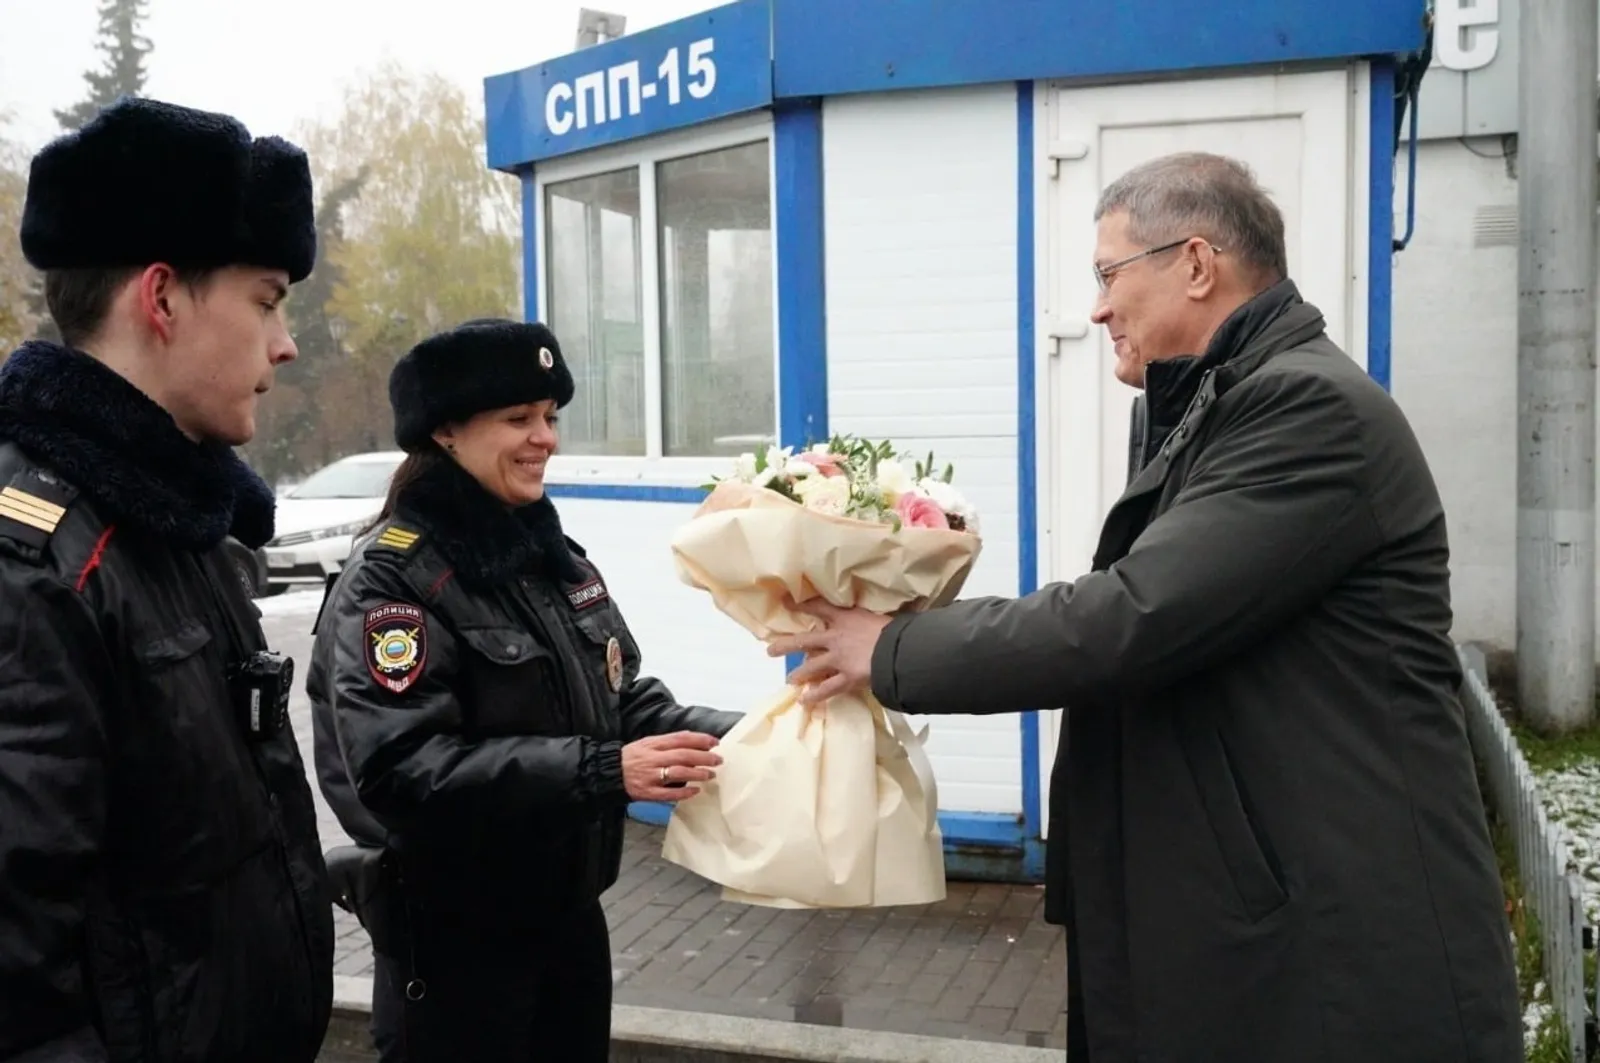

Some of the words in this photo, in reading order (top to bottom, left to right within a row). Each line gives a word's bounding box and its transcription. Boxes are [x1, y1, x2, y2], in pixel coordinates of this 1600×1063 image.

[545, 38, 717, 136] СПП-15
[370, 606, 419, 621] ПОЛИЦИЯ
[386, 676, 410, 693] МВД
